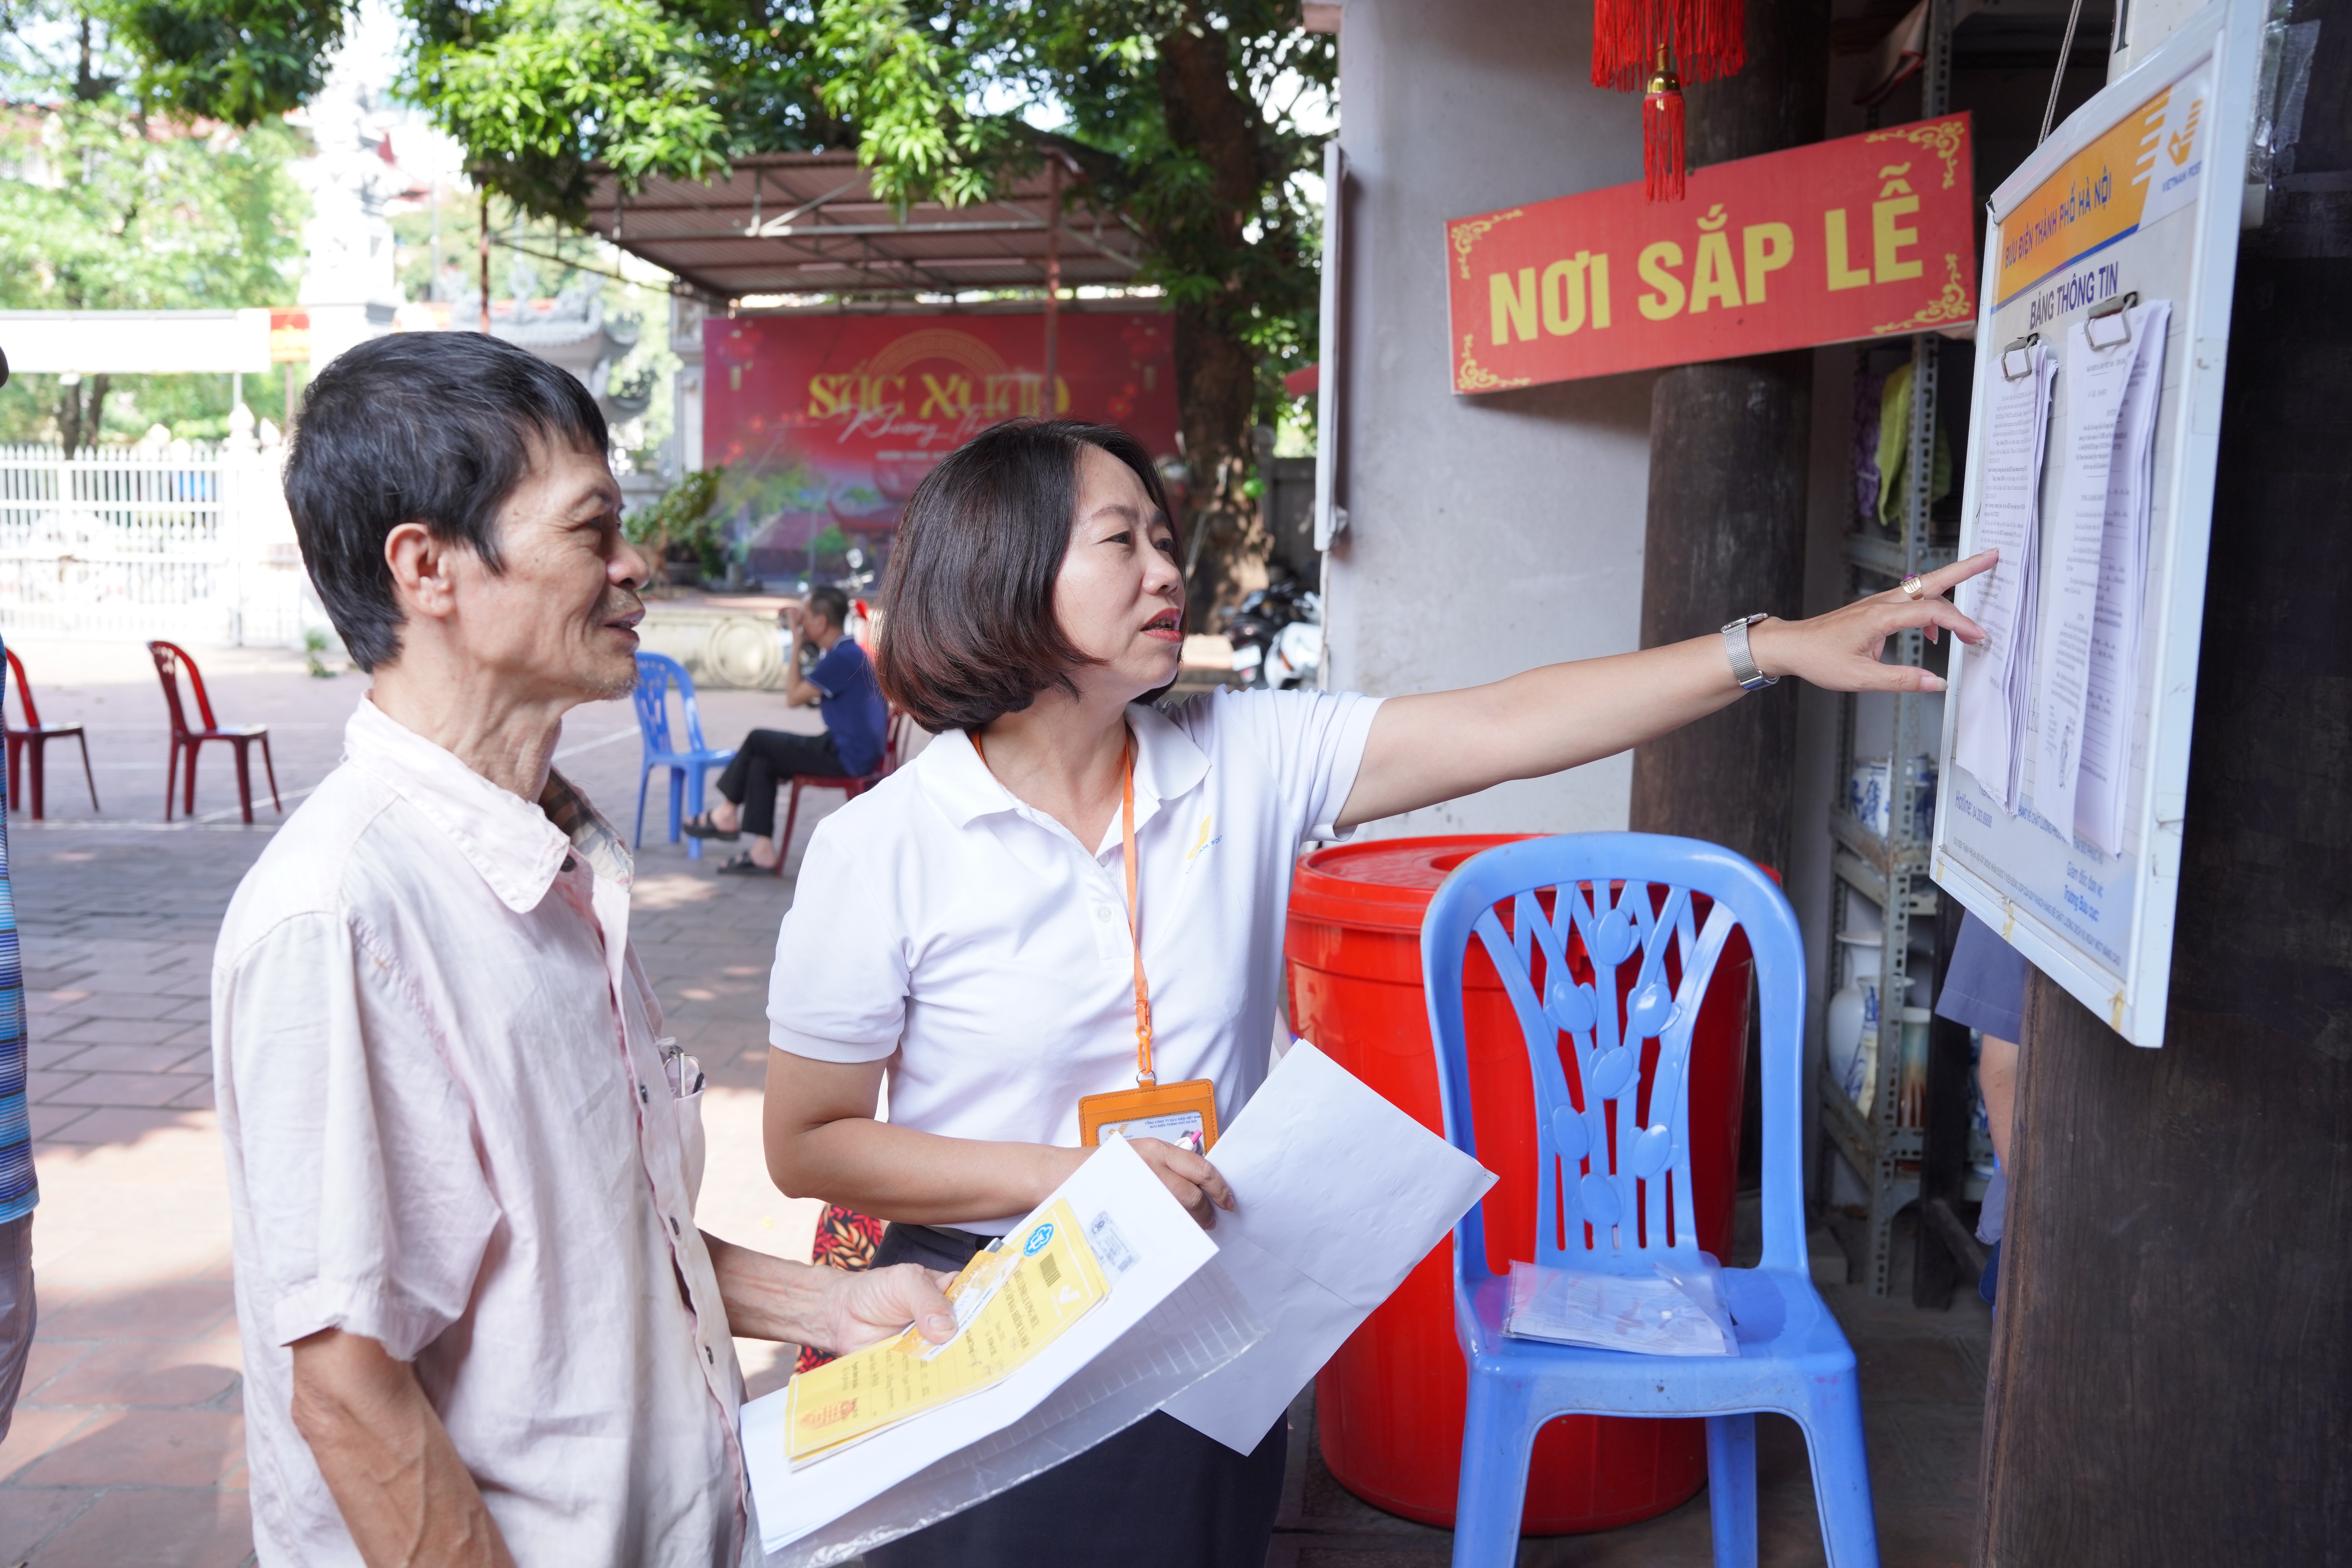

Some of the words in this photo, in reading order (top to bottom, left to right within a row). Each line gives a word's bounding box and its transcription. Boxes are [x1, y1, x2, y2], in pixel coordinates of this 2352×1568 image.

[2018, 222, 2033, 260] ĐIỆN
[2035, 208, 2057, 247] THÀNH
[2060, 181, 2075, 230] PHỐ
[2079, 176, 2091, 217] HÀ
[2094, 165, 2111, 210] NỘI
[1488, 250, 1611, 346] NƠI
[1637, 203, 1794, 321] SẮP
[1824, 162, 1924, 291] LỄ
[2030, 291, 2054, 330] BẢNG
[2057, 273, 2095, 316] THÔNG
[2099, 261, 2118, 299] TIN
[1955, 789, 1973, 816] Hotline:
[1211, 835, 1222, 845] POST
[1011, 1267, 1024, 1285] HIẾU
